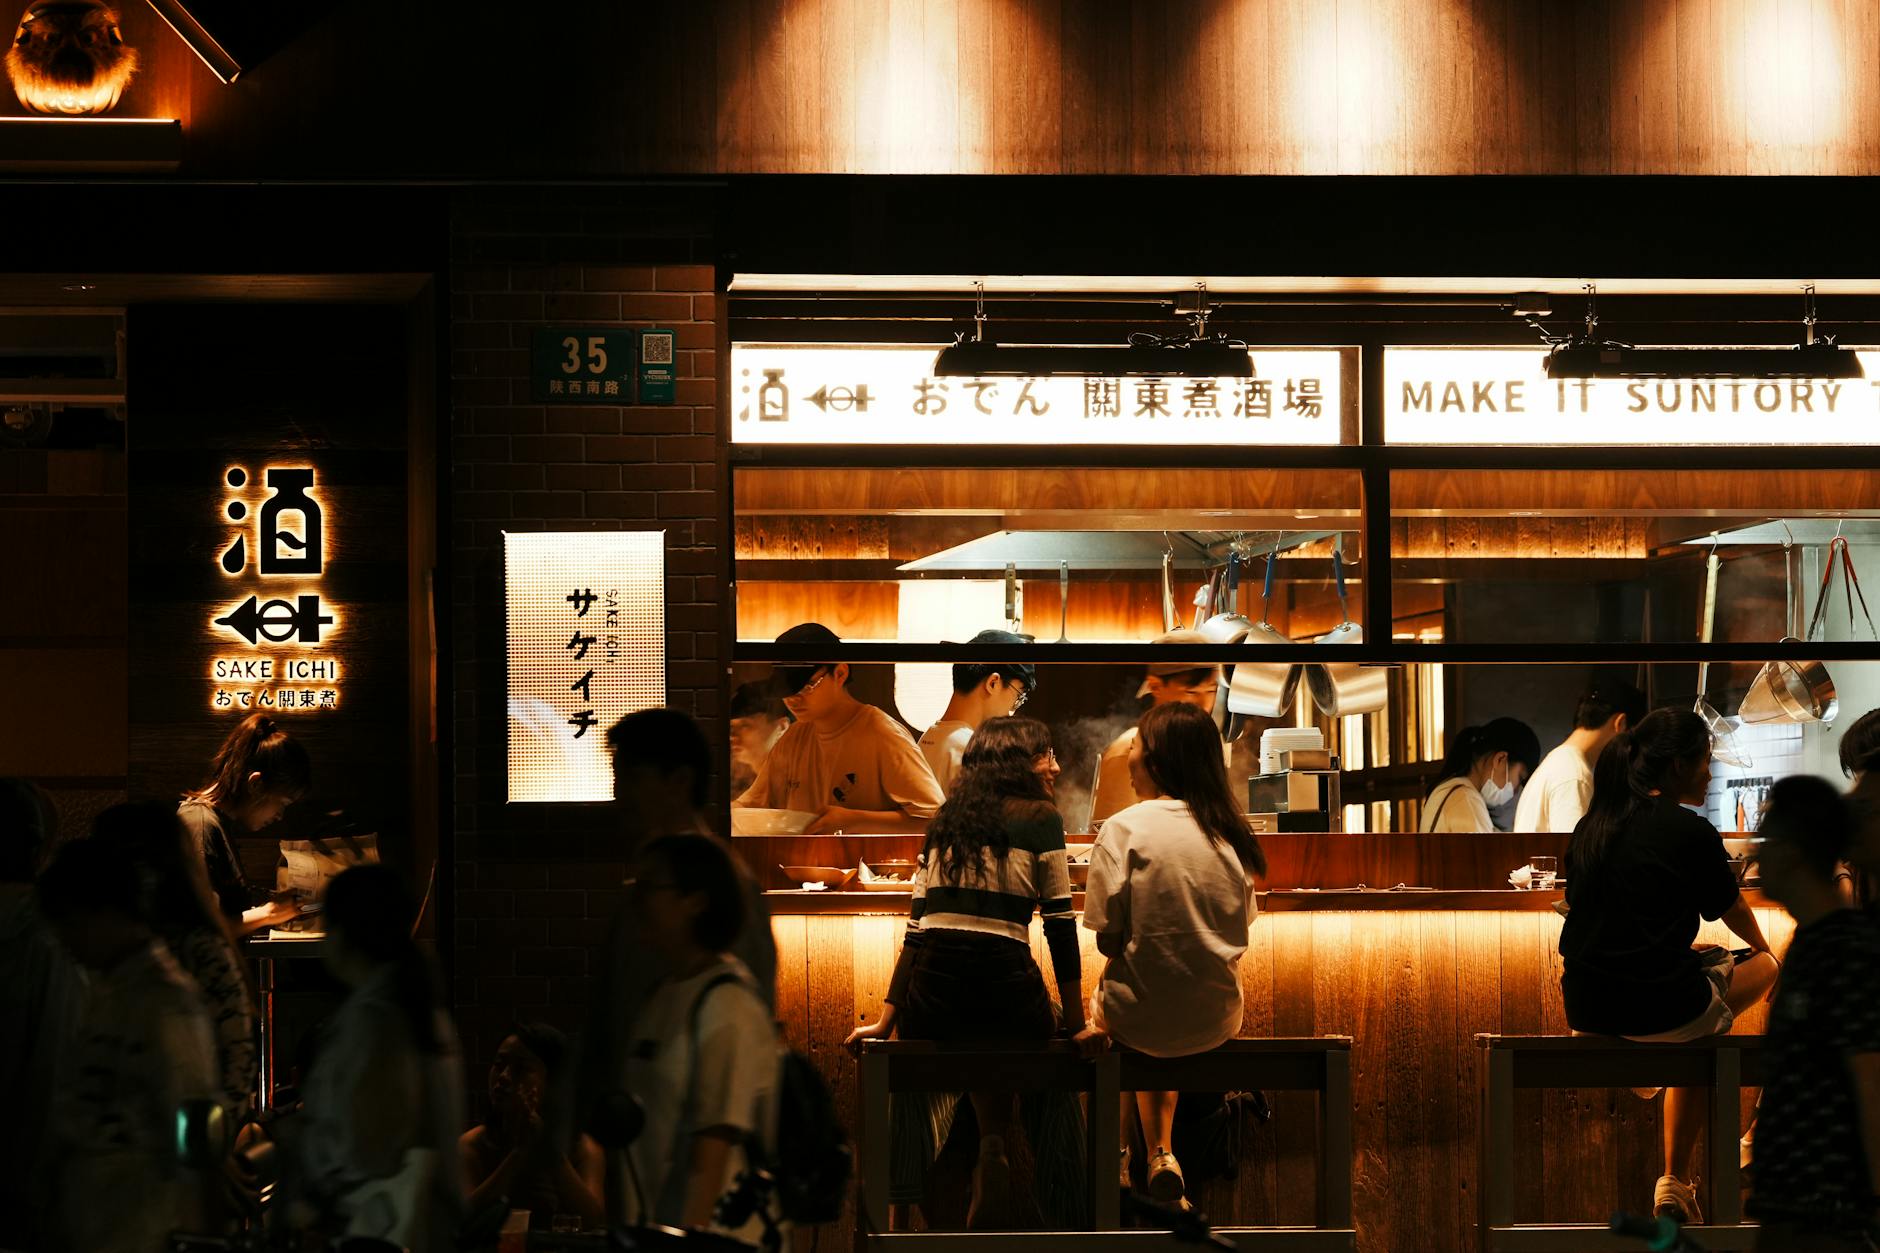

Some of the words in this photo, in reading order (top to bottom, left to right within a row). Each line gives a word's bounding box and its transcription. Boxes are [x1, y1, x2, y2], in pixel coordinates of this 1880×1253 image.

[561, 336, 608, 374] 35
[912, 377, 1050, 416] おでん
[1402, 380, 1526, 413] MAKE
[1557, 378, 1594, 413] IT
[1627, 378, 1842, 413] SUNTORY
[605, 589, 618, 628] SAKE
[216, 660, 273, 679] SAKE
[288, 660, 335, 679] ICHI
[566, 588, 598, 739] サケイチ
